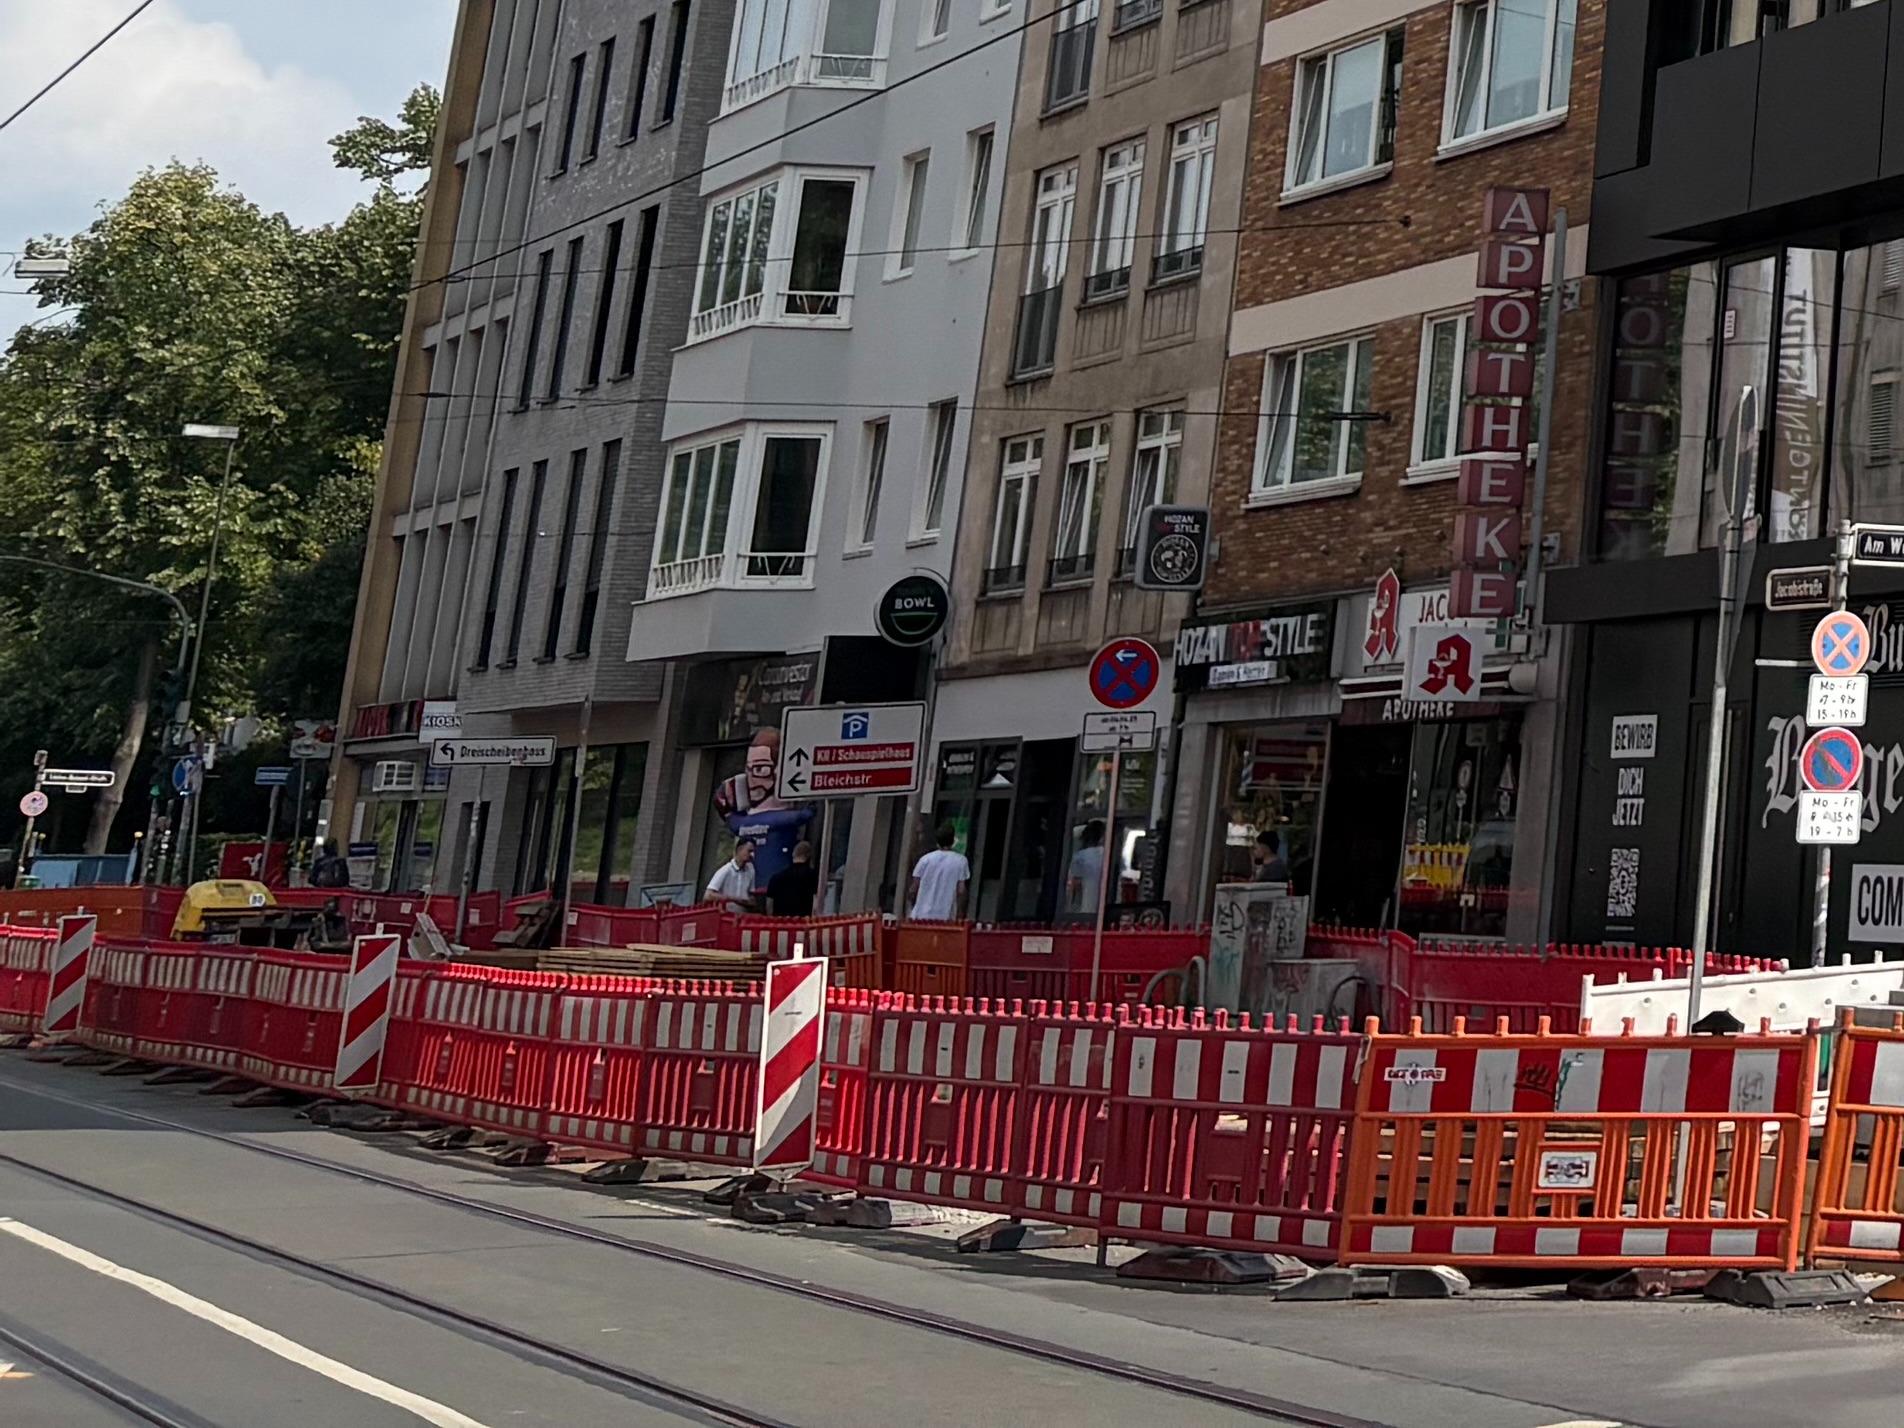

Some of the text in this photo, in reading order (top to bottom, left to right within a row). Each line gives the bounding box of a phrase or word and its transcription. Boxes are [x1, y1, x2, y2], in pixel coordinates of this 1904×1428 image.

[1469, 192, 1540, 616] APOTHEKE
[1864, 535, 1885, 554] Am
[894, 596, 935, 609] BOWL
[1263, 613, 1322, 658] STYLE
[1820, 680, 1835, 691] Mo
[1382, 698, 1455, 722] APOTHEKE
[423, 713, 464, 728] KIOSK
[460, 745, 547, 759] Dreischeibenhaus
[1618, 766, 1645, 796] DICH
[1611, 797, 1645, 827] JETZT
[1812, 797, 1829, 808] Mo
